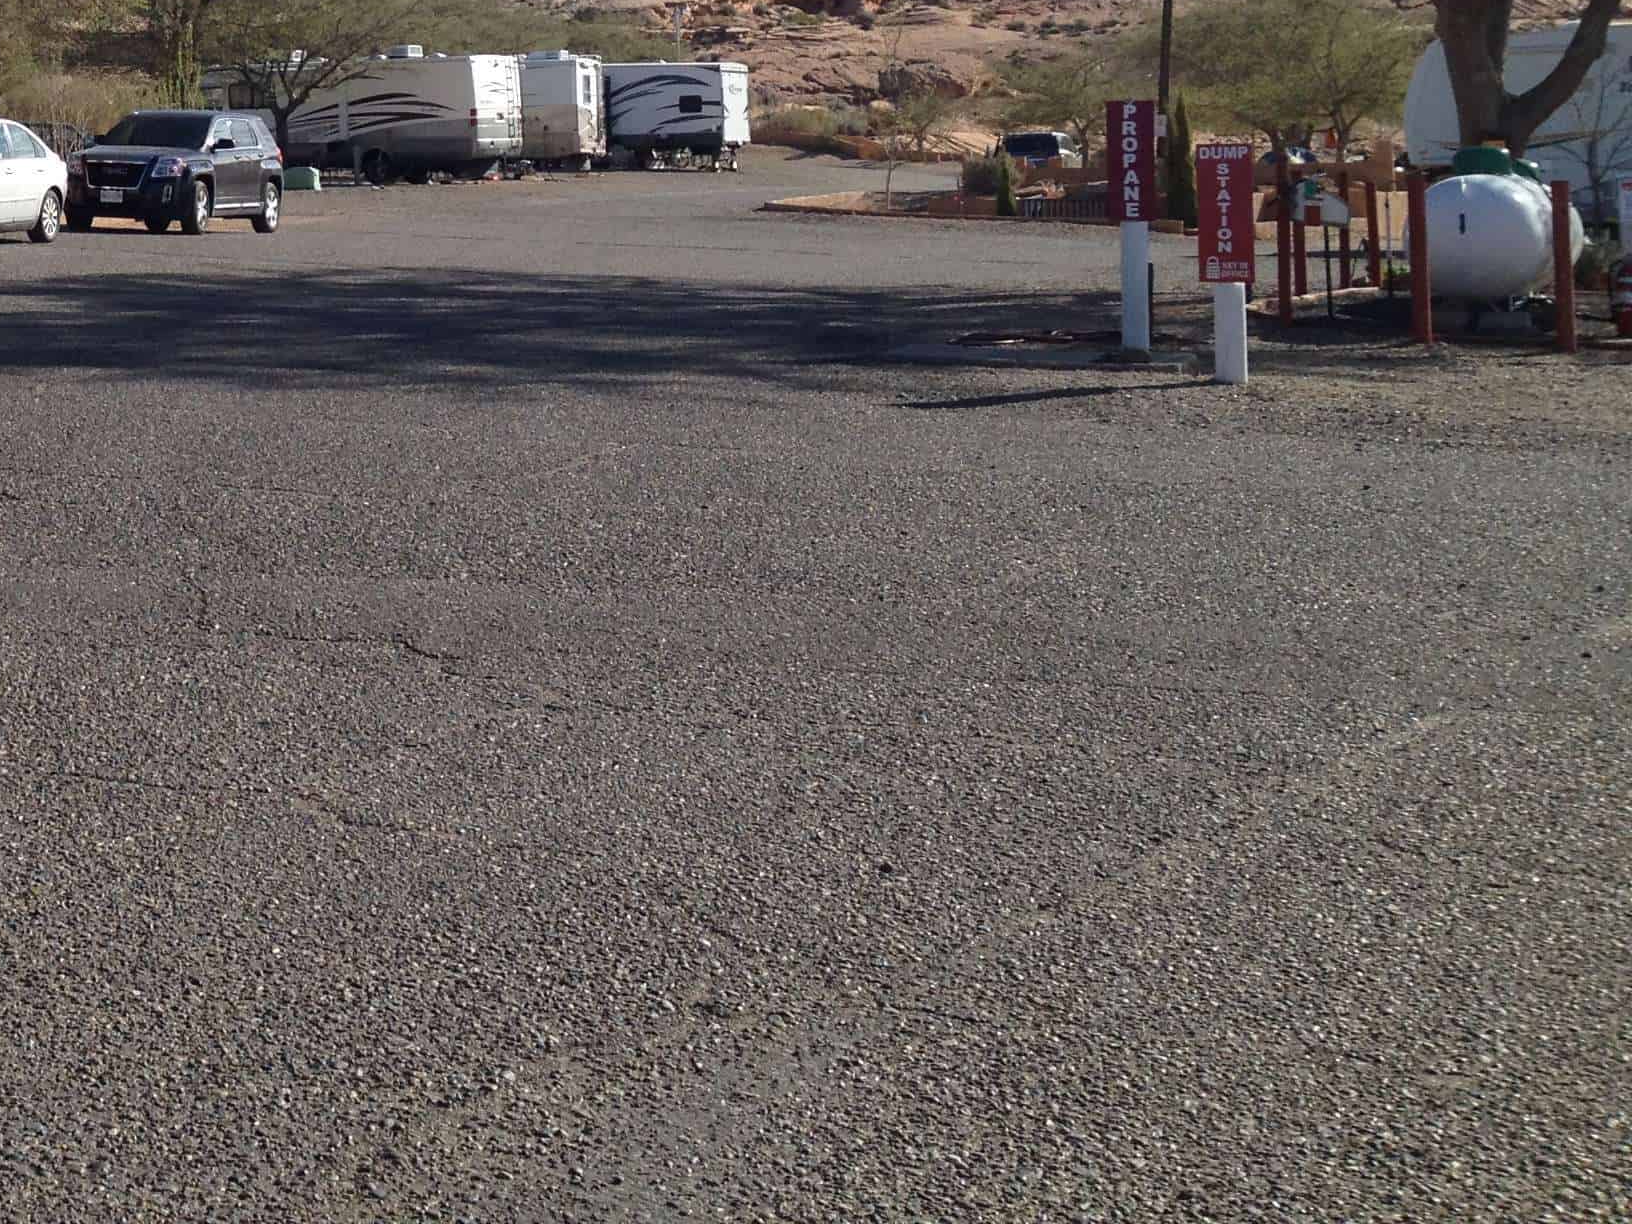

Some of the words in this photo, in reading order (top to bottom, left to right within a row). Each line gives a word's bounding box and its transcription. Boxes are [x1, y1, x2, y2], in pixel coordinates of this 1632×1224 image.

[1121, 104, 1141, 218] PROPANE
[1199, 146, 1248, 160] DUMP
[1216, 163, 1233, 253] STATION
